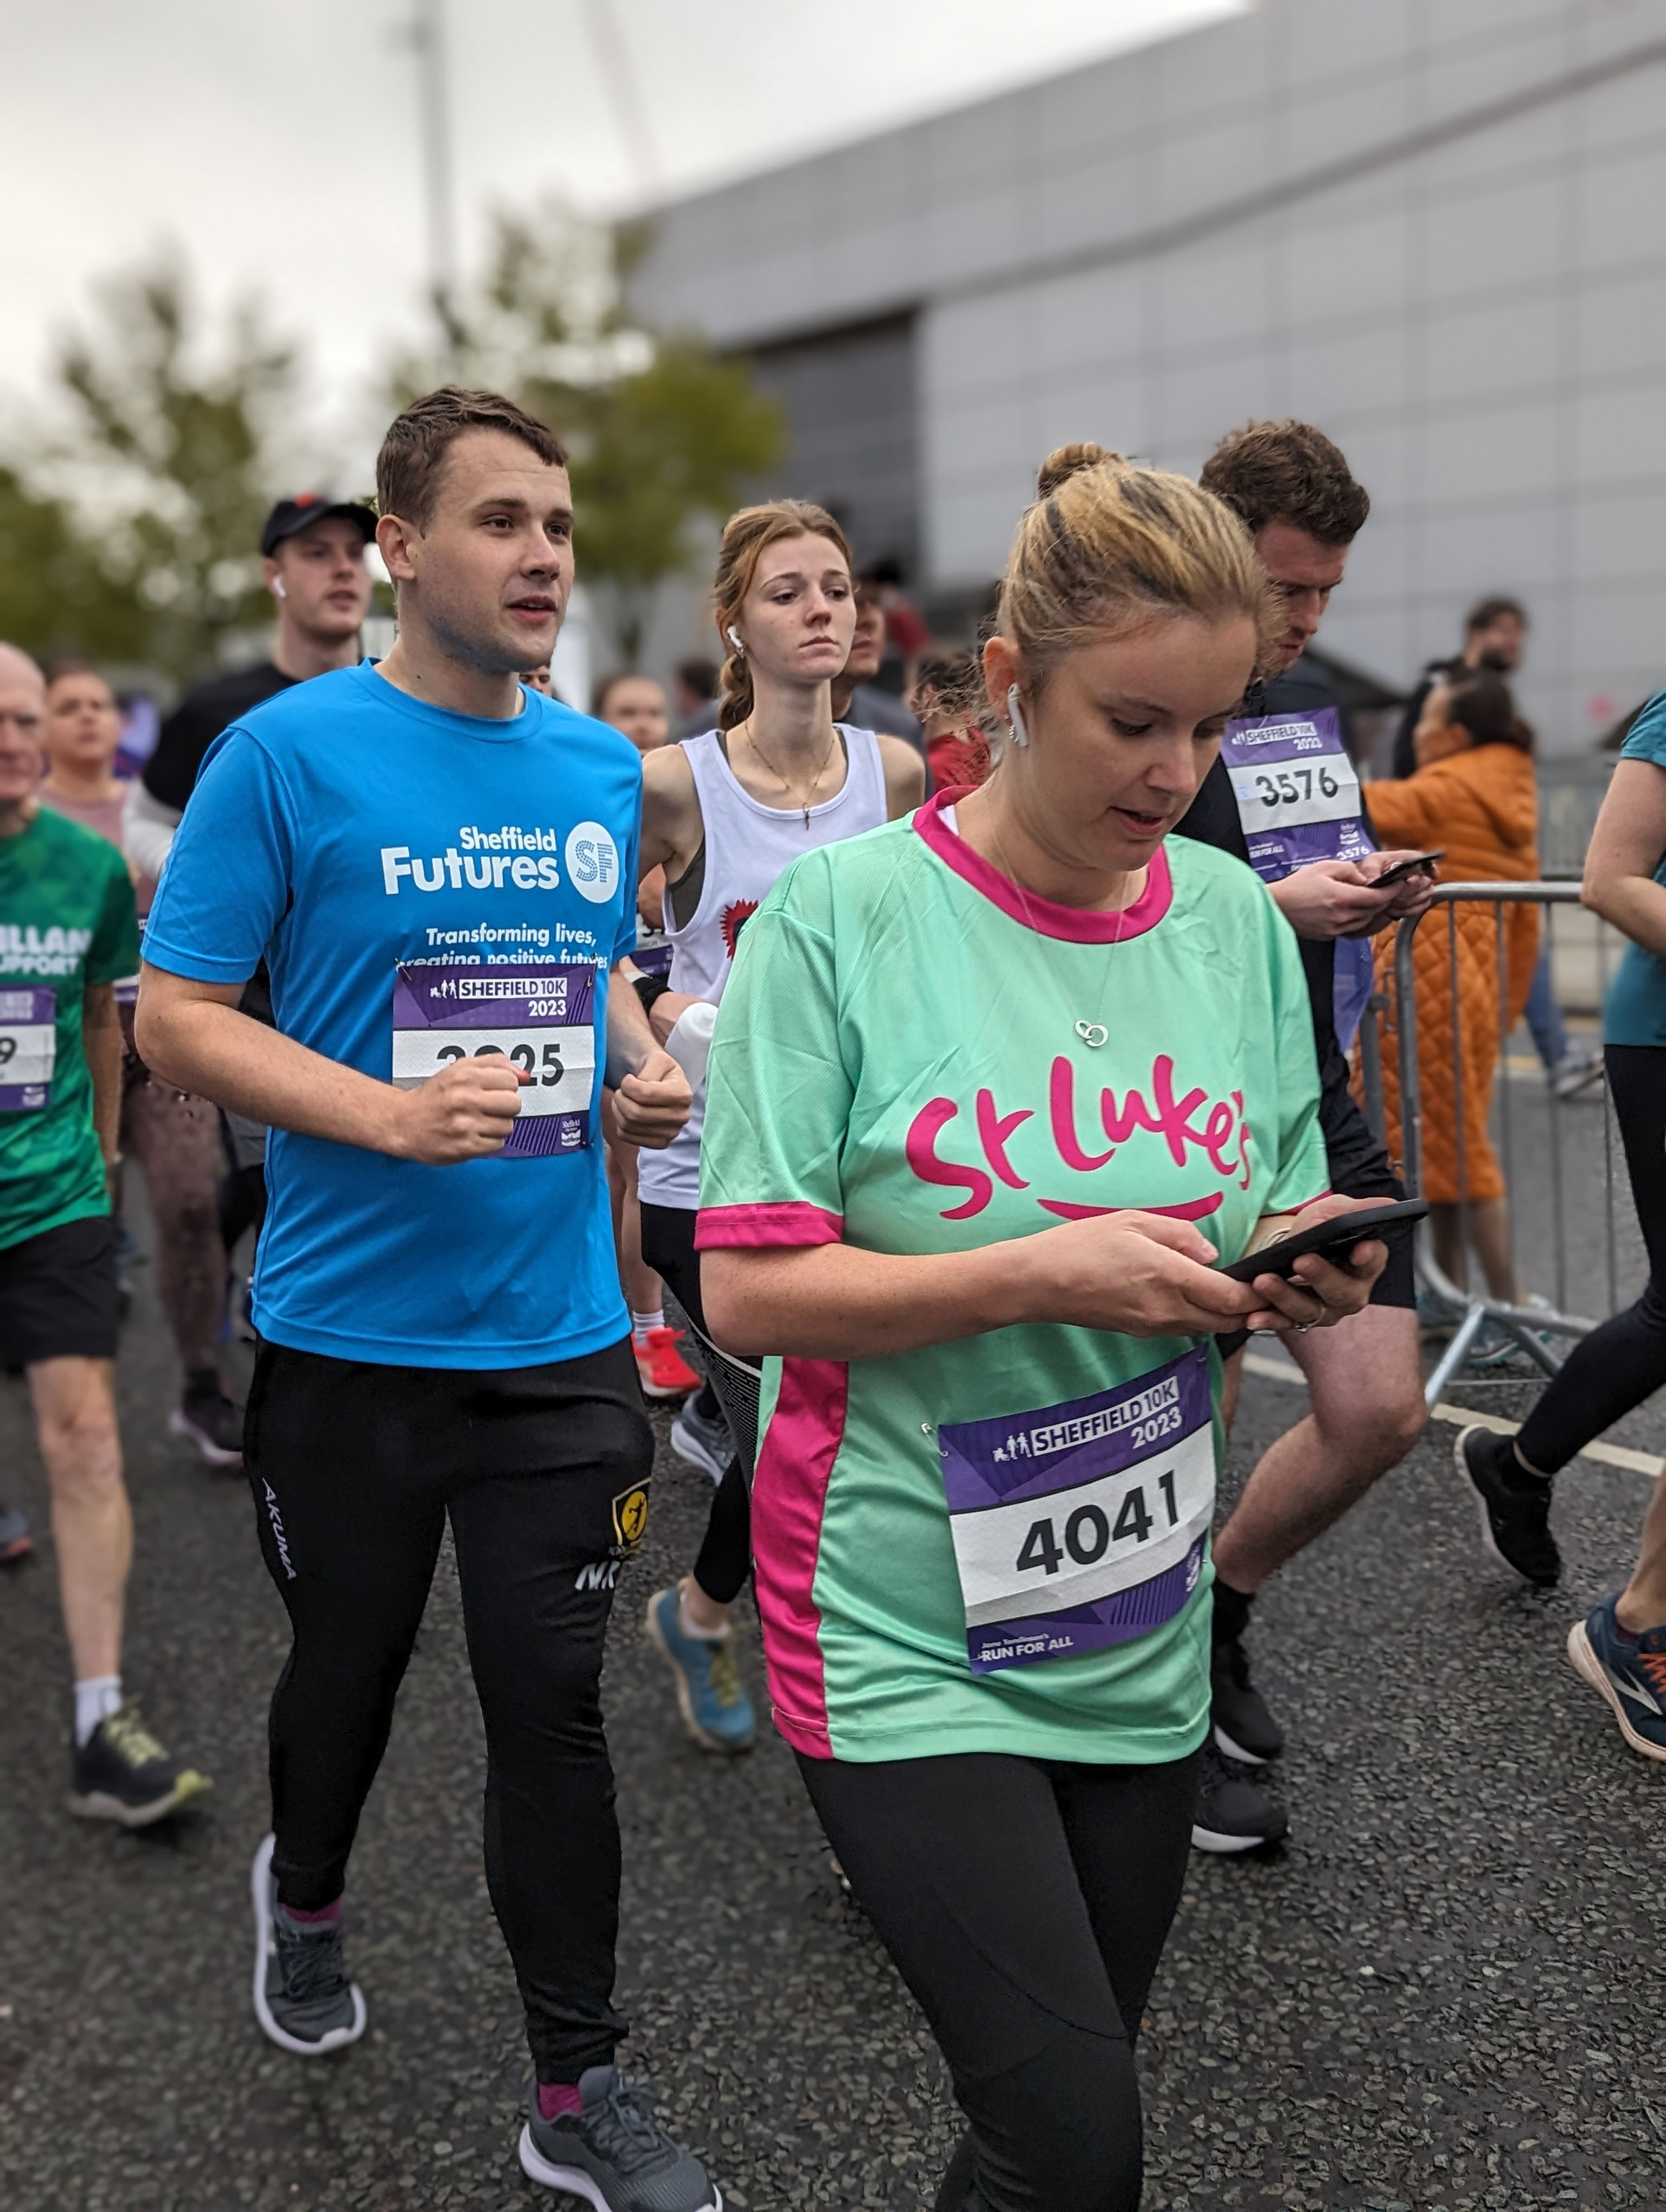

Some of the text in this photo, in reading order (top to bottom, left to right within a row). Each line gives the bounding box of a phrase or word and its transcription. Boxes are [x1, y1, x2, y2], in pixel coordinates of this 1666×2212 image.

[1247, 726, 1297, 743] SHEFFIELD
[1293, 737, 1323, 750] 2023
[1255, 767, 1338, 807] 3576
[460, 826, 557, 851] Sheffield
[1337, 847, 1370, 861] 3576
[380, 846, 560, 895] Futures
[575, 840, 613, 884] SF
[426, 923, 597, 948] Transforming lives,
[461, 980, 565, 996] SHEFFIELD 10K
[528, 1000, 567, 1017] 2023
[0, 1037, 17, 1065] 9
[437, 1043, 565, 1086] 25
[906, 1088, 1035, 1219] St
[1035, 1380, 1176, 1451] SHEFFIELD 10K
[1131, 1406, 1182, 1449] 2023
[262, 1477, 297, 1580] AKUMA
[1016, 1470, 1180, 1576] 4041
[981, 1636, 1074, 1662] RUN FOR ALL
